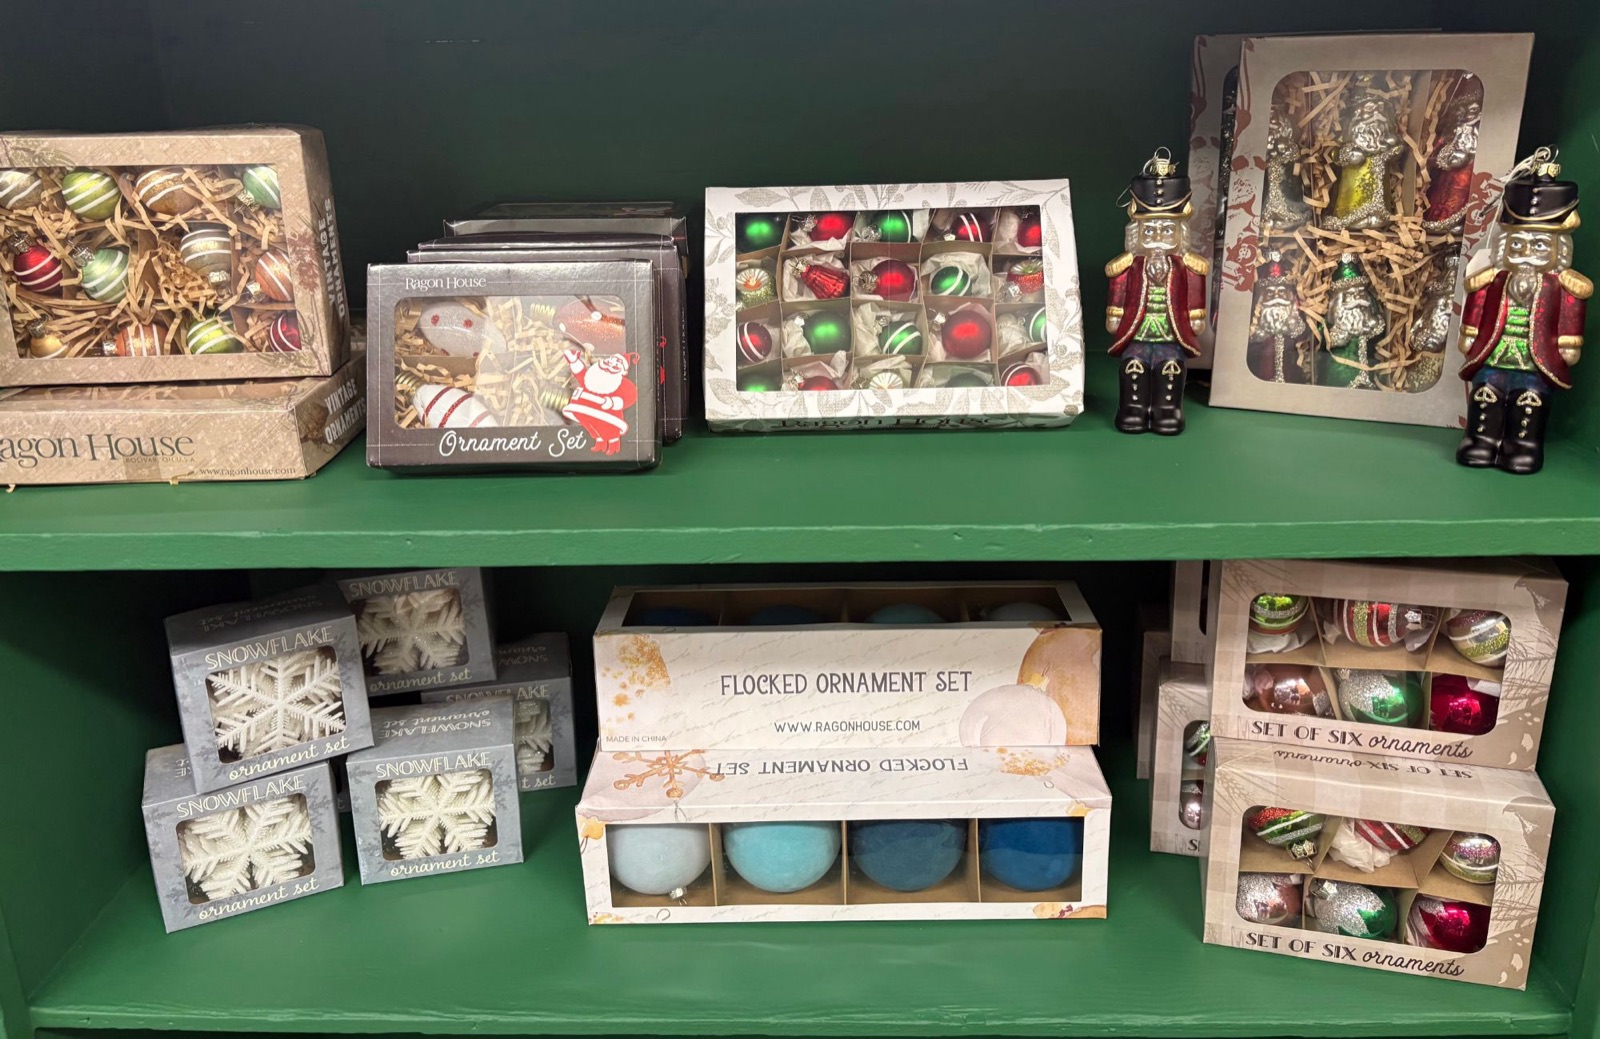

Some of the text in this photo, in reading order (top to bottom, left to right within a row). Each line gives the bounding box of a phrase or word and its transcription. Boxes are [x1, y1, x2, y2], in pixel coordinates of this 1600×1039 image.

[318, 216, 335, 306] VINTAGE
[325, 198, 346, 318] ORNAMENTS
[404, 277, 487, 292] Ragon House
[324, 378, 358, 415] VINTAGE
[0, 434, 196, 469] agon House
[439, 428, 588, 457] Ornament Set
[200, 466, 296, 477] www.ragonhouse.com
[350, 571, 460, 598] SNOWFLAKE
[204, 625, 335, 671] SNOWFLAKE
[369, 667, 473, 692] ornament set
[720, 670, 972, 695] FLOCKED ORNAMENT SET
[378, 718, 492, 738] SNOWFLAKE
[411, 709, 491, 724] ornament
[774, 720, 920, 733] WWW.RAGONHOUSE.COM
[606, 735, 667, 743] MADE IN CHINA
[1250, 720, 1473, 759] SET OF SIX ornaments
[228, 743, 320, 781] ornament
[323, 735, 351, 754] set
[375, 752, 492, 778] SNOWFLAKE
[713, 758, 969, 776] FLOCKED ORNAMENT SET
[1273, 749, 1474, 779] SET OF SIX ornaments
[534, 775, 557, 787] set
[176, 774, 306, 818] SNOWFLAKE
[390, 850, 501, 877] ornament set
[198, 877, 320, 920] ornament set
[1245, 932, 1465, 977] SET OF SIX ornaments
